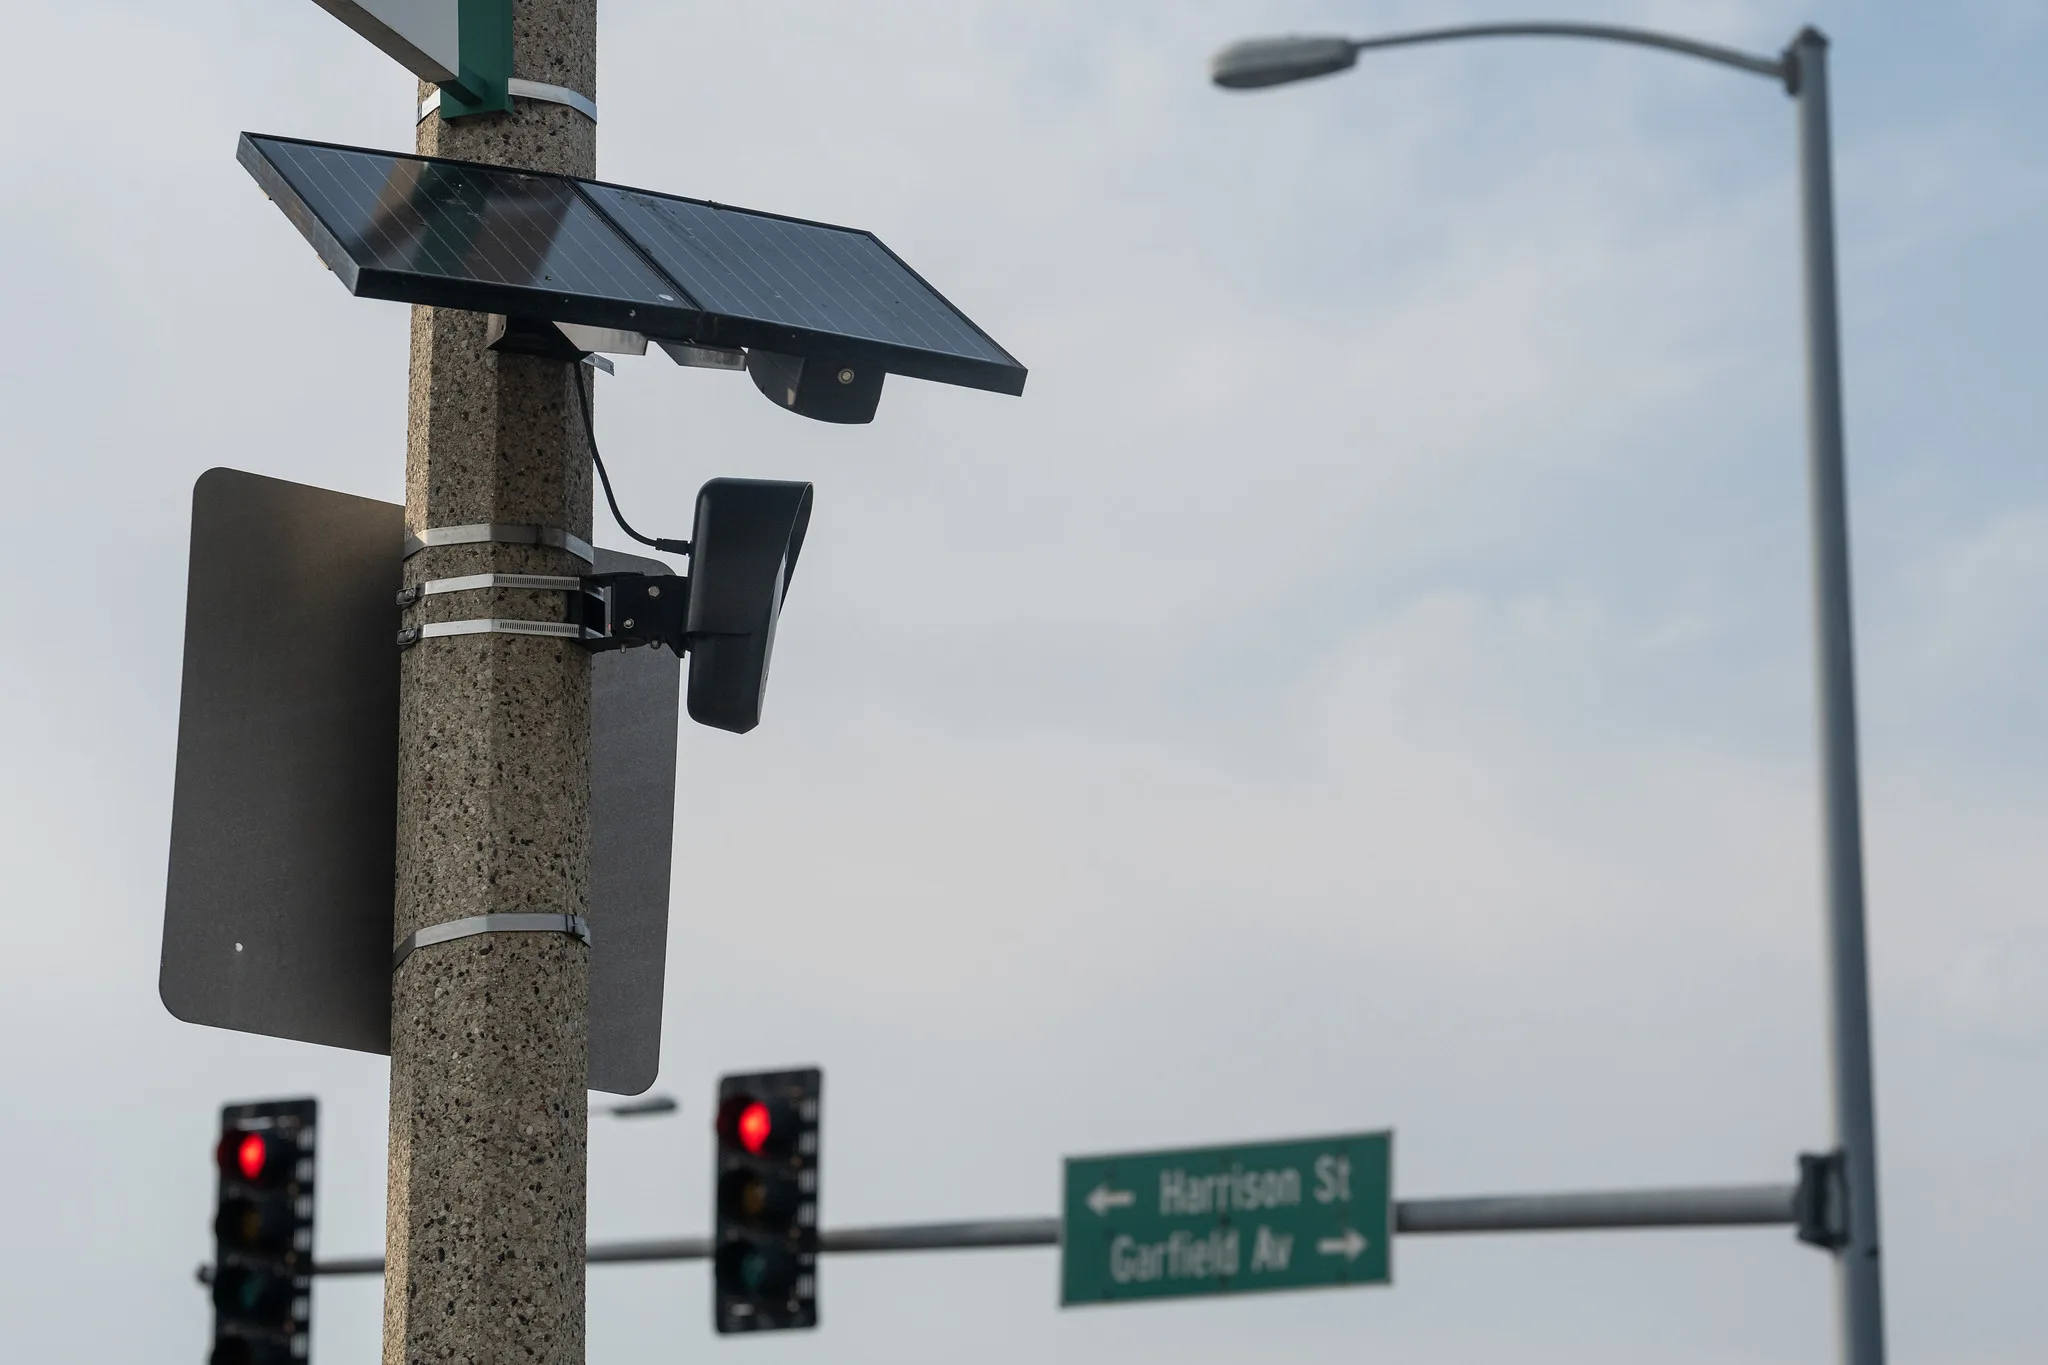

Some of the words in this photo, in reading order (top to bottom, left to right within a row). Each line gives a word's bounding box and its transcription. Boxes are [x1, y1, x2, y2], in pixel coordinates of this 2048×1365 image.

[1159, 1165, 1302, 1215] Harrison
[1314, 1155, 1352, 1204] St
[1110, 1228, 1240, 1283] Garfield
[1251, 1225, 1294, 1272] Av
